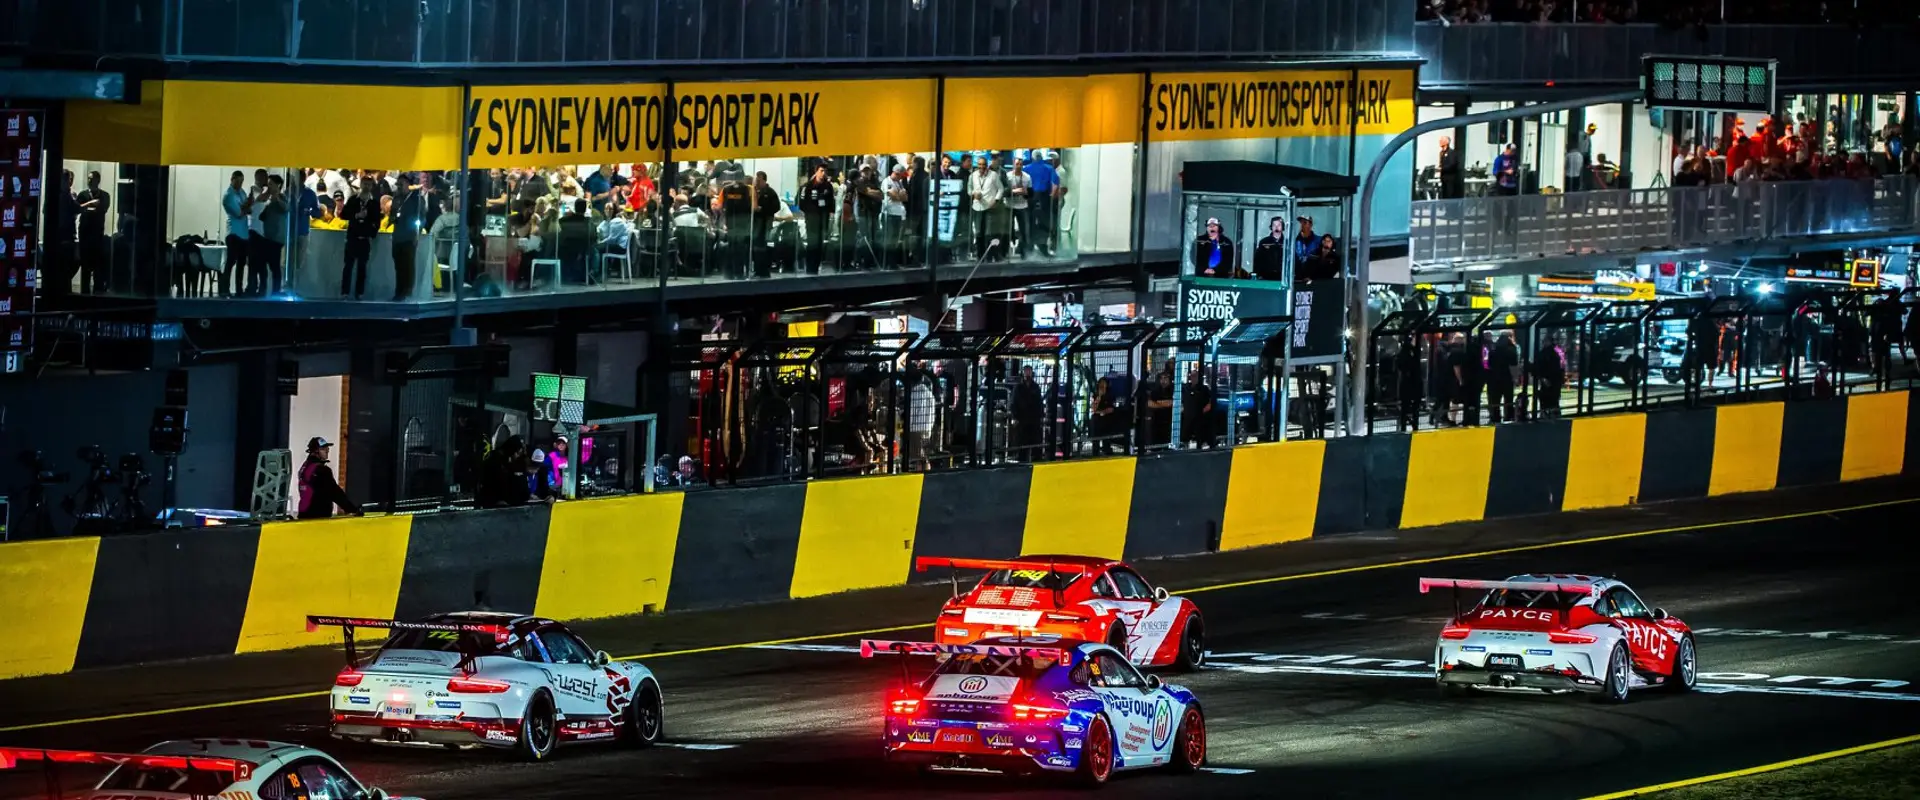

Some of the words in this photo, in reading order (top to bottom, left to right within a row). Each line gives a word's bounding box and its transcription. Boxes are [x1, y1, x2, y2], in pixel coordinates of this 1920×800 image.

[1155, 83, 1229, 131] SYDNEY
[1230, 80, 1345, 129] MOTORSPORT
[486, 96, 590, 156] SYDNEY
[758, 91, 820, 147] PARK
[1538, 283, 1594, 293] Blackwoods
[1188, 289, 1241, 306] SYDNEY
[1187, 303, 1234, 320] MOTOR
[1480, 610, 1553, 622] PAYCE
[1616, 619, 1668, 660] PAYCE
[386, 706, 406, 715] Mobil
